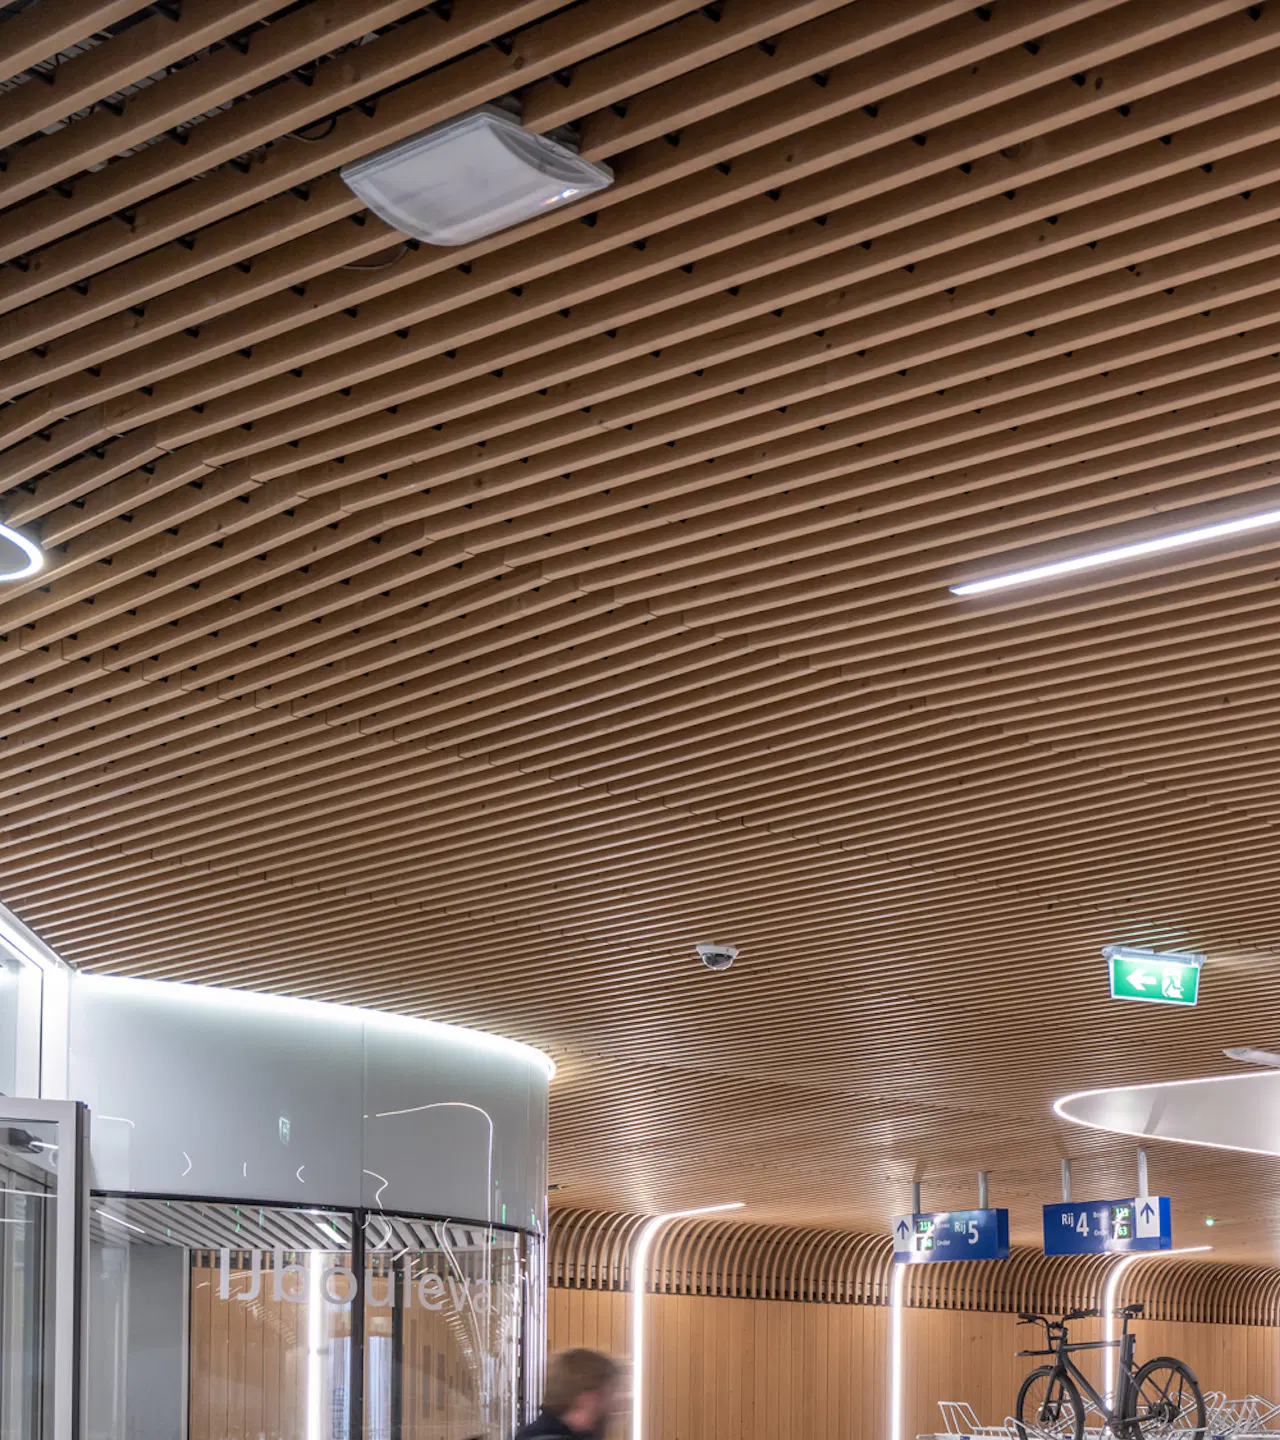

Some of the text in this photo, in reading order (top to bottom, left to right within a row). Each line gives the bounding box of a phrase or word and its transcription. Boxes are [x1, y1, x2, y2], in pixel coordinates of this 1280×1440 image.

[954, 1220, 979, 1245] Rij 5
[1061, 1212, 1090, 1237] Rij 4
